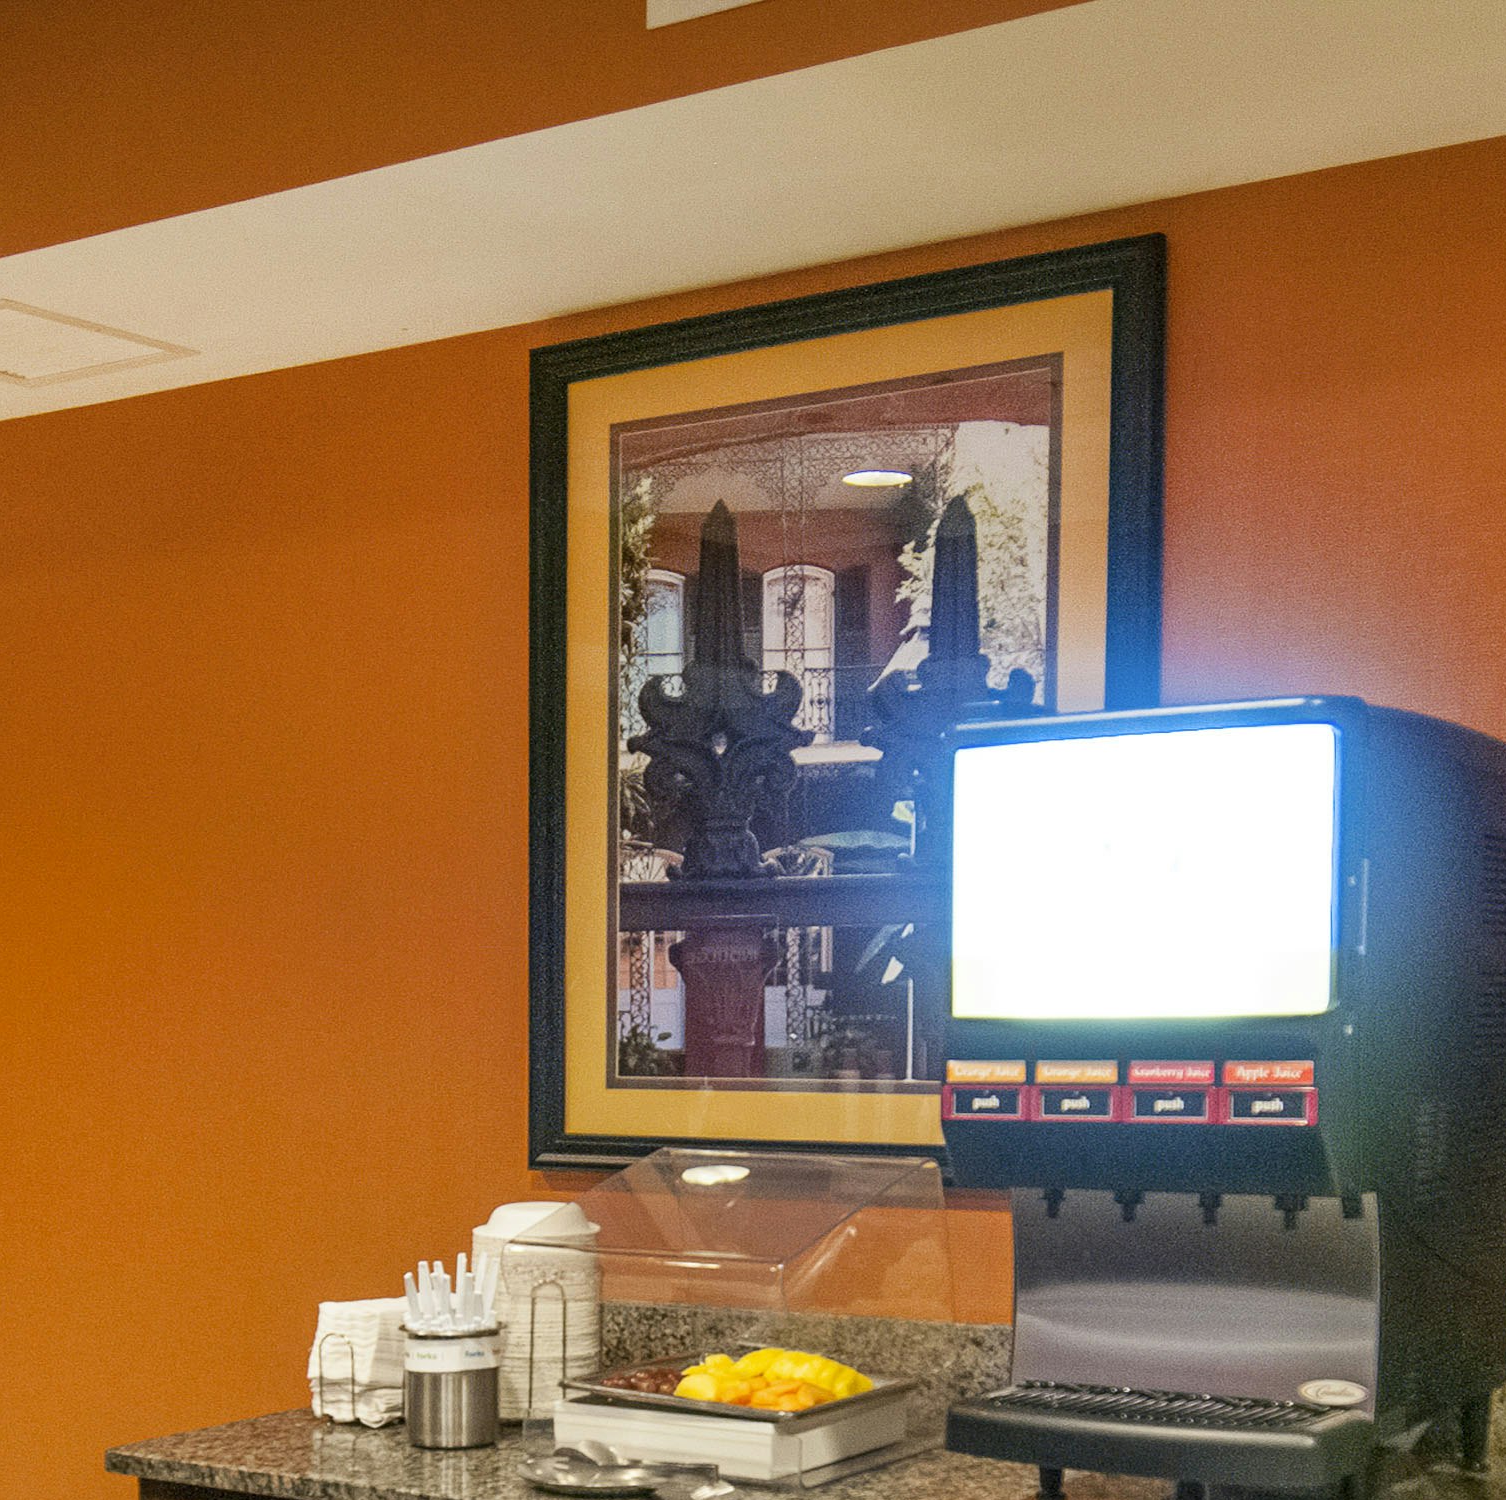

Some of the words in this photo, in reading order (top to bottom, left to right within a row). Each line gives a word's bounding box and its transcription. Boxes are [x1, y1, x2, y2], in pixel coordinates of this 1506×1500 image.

[1133, 1066, 1184, 1081] Cranberry
[1186, 1066, 1212, 1079] Juice
[1235, 1065, 1269, 1081] Apple
[1271, 1066, 1304, 1079] Juice
[972, 1094, 1000, 1111] push
[1060, 1095, 1091, 1112] push
[1153, 1096, 1185, 1113] push
[1250, 1097, 1285, 1114] push
